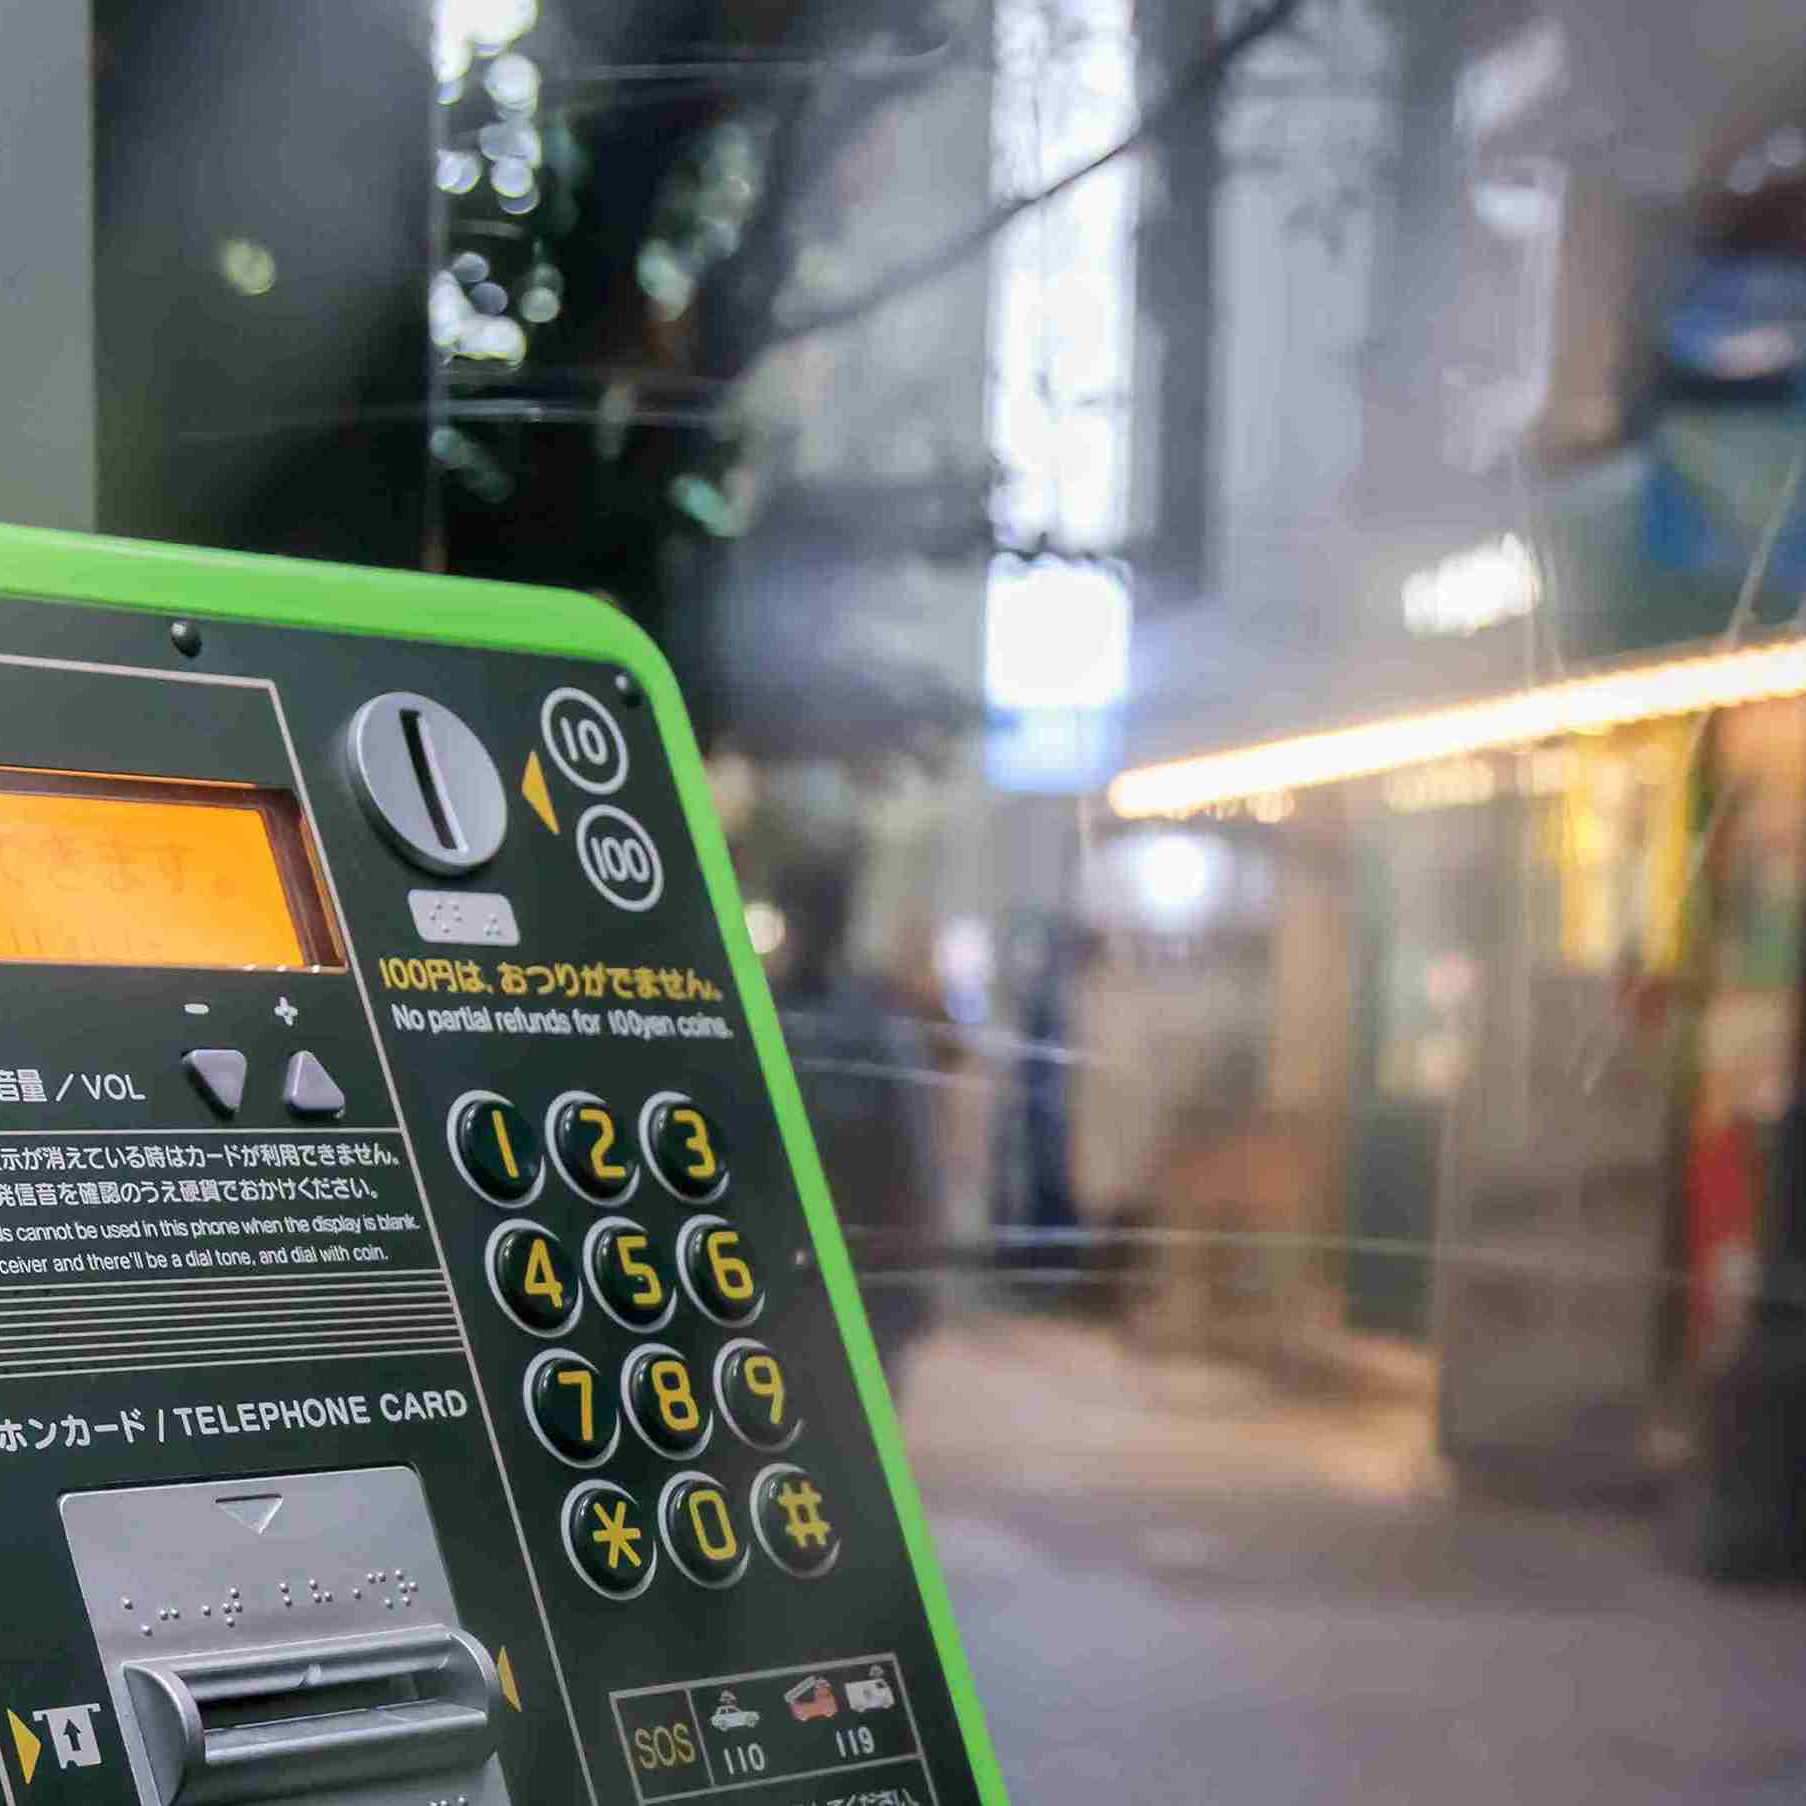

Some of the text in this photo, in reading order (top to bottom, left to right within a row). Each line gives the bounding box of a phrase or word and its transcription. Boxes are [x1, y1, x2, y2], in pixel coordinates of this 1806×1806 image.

[559, 715, 608, 766] 10
[591, 835, 650, 883] 100
[391, 1003, 425, 1032] No
[427, 1005, 493, 1034] partial
[495, 1006, 572, 1035] refunds
[572, 1008, 601, 1035] for
[491, 1108, 717, 1180] 1 2 3
[16, 1223, 74, 1242] cannot
[74, 1221, 98, 1240] be
[100, 1220, 141, 1239] used
[141, 1219, 159, 1238] in
[159, 1219, 189, 1237] this
[190, 1219, 240, 1239] phone
[240, 1217, 283, 1235] when
[283, 1216, 311, 1233] the
[312, 1214, 361, 1235] display
[362, 1214, 378, 1231] is
[52, 1253, 85, 1272] and
[86, 1251, 144, 1271] there'll
[144, 1251, 168, 1269] be
[171, 1253, 183, 1268] a
[185, 1249, 213, 1267] dial
[215, 1248, 256, 1268] tone,
[258, 1247, 289, 1265] and
[290, 1245, 318, 1264] dial
[318, 1245, 351, 1263] with
[353, 1244, 389, 1262] coin.
[523, 1231, 754, 1309] 4 5 6
[379, 1389, 468, 1422] CARD
[557, 1354, 785, 1441] 7 8 9
[689, 1488, 737, 1560] 0
[777, 1481, 831, 1548] #
[635, 1723, 695, 1770] SOS
[722, 1743, 766, 1776] 110
[835, 1726, 876, 1758] 119
